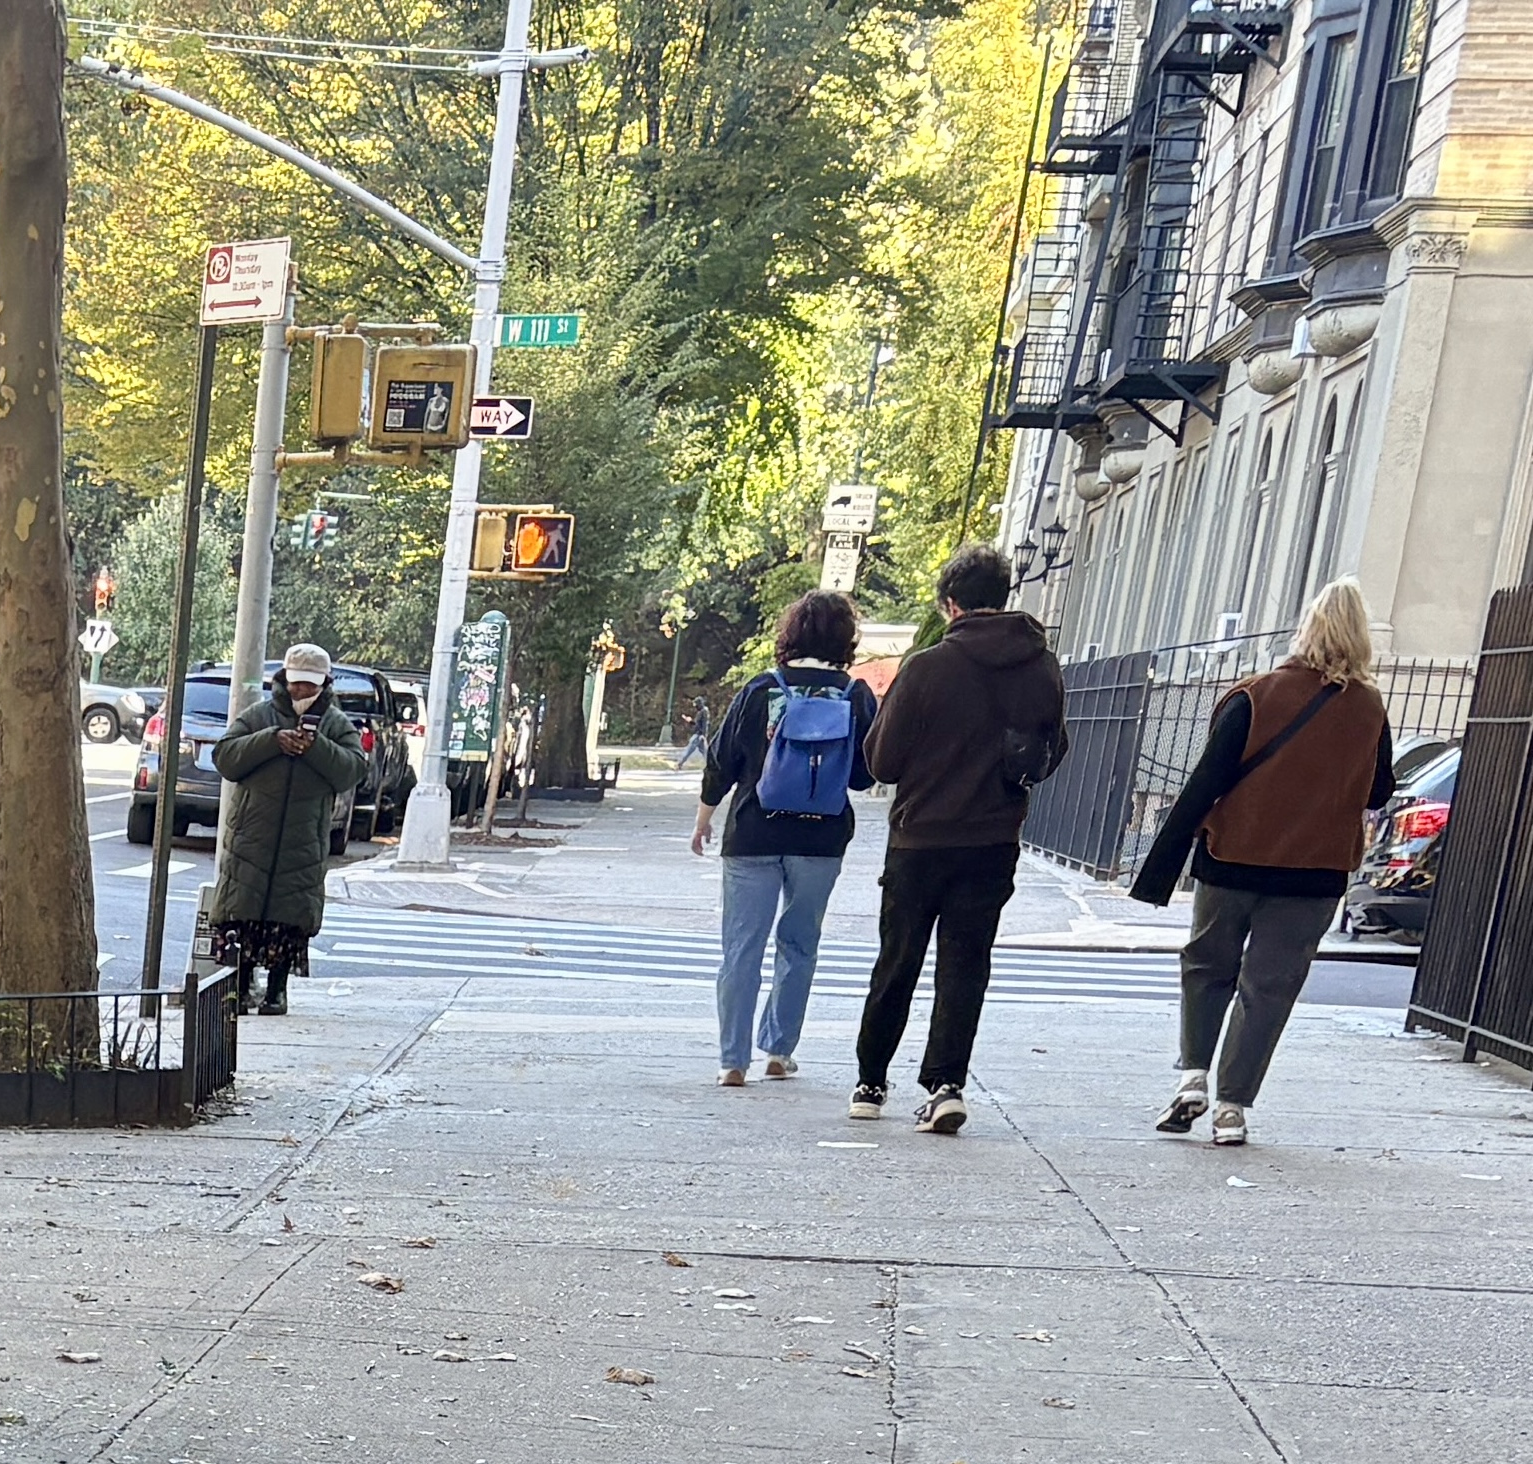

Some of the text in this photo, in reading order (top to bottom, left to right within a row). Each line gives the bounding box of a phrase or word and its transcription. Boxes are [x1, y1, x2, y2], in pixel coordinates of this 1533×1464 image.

[509, 318, 569, 343] W 111 St
[481, 410, 514, 425] WAY
